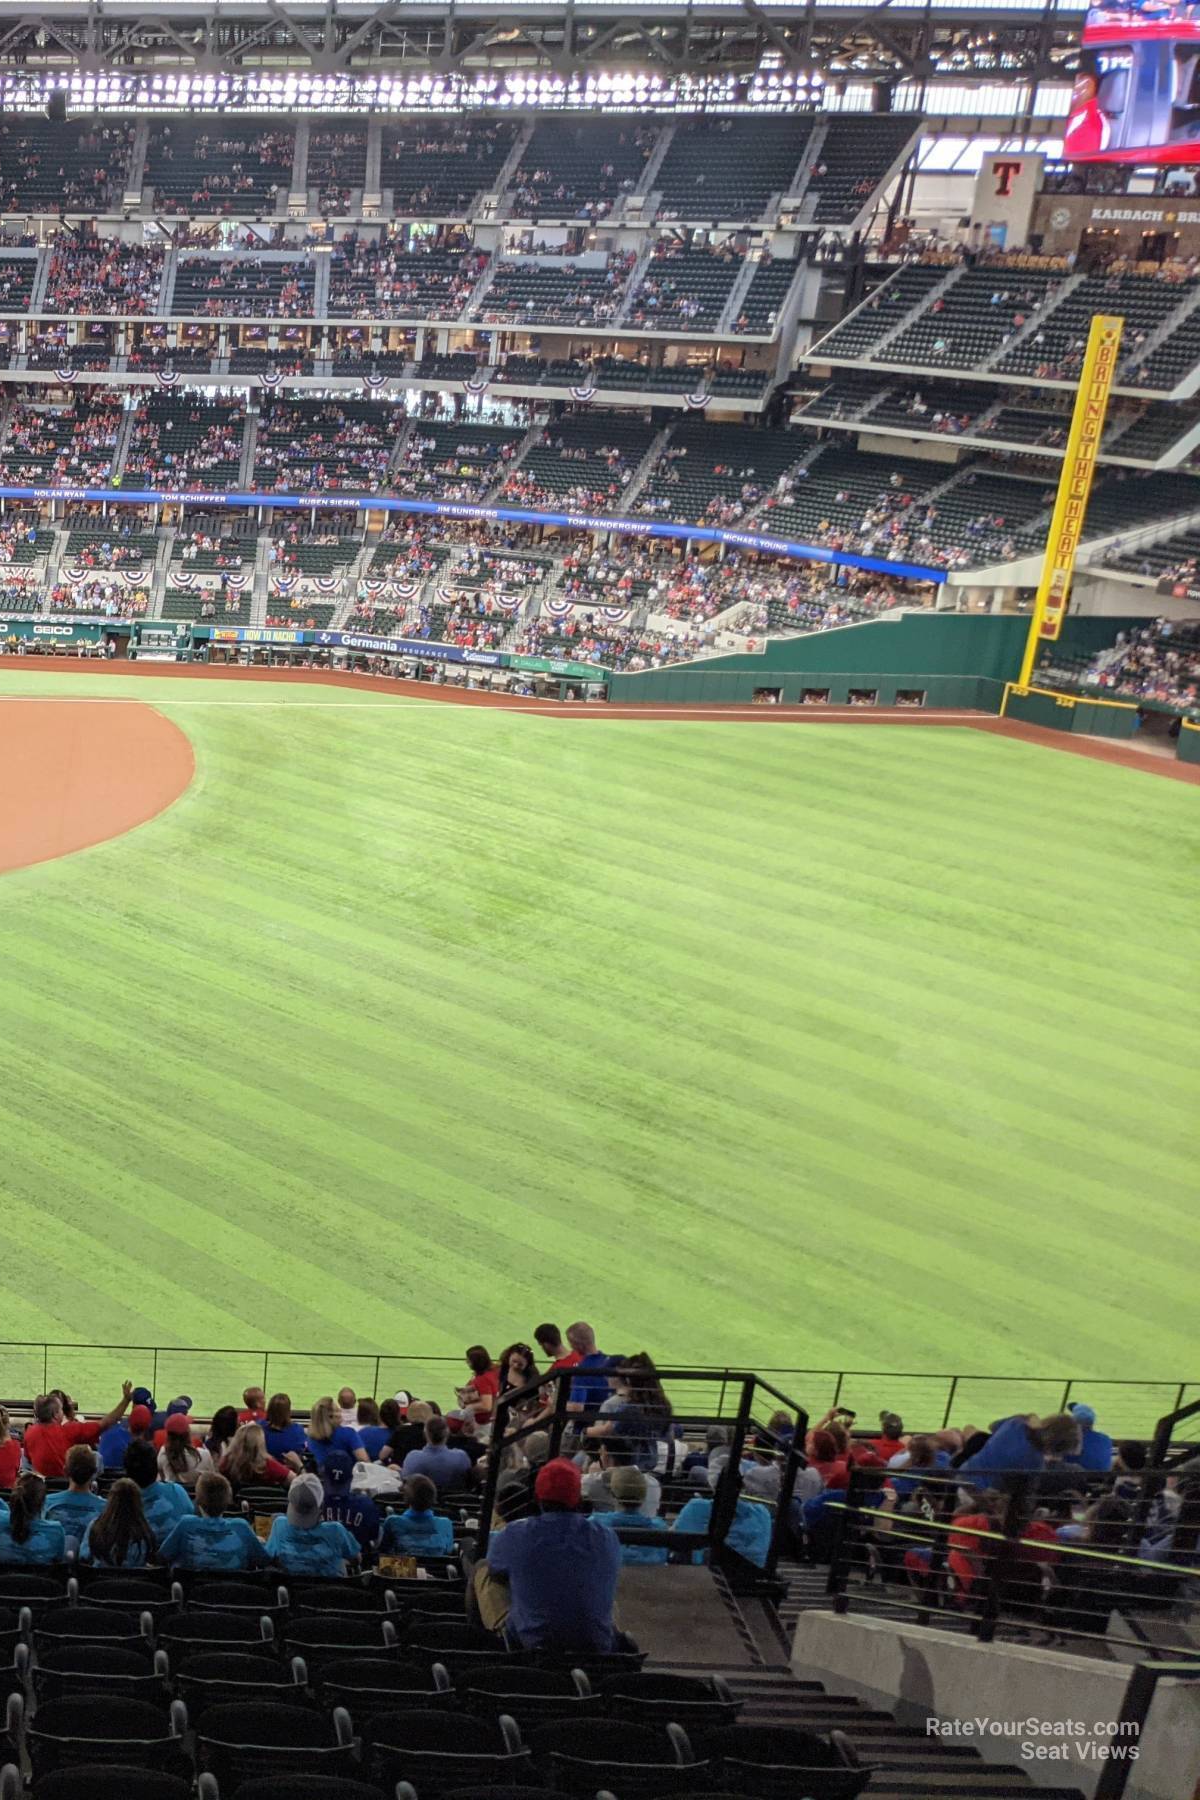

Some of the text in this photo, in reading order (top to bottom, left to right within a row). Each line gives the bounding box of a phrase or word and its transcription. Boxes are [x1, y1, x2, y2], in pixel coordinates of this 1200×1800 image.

[993, 162, 1022, 196] T
[1091, 208, 1163, 221] KARBACH
[33, 490, 62, 498] NOLAN
[179, 494, 226, 503] SCHIEFFER
[329, 499, 361, 507] SIERRA
[436, 505, 498, 518] JIM SUNDBERG
[567, 518, 652, 532] TOM VANDERGRIFF
[722, 533, 789, 552] MICHAEL YOUNG
[33, 625, 73, 635] GEICO
[244, 629, 261, 641] HOW
[341, 634, 448, 658] Germania INSURANCE
[332, 1468, 343, 1480] T
[320, 1507, 364, 1527] ALLO
